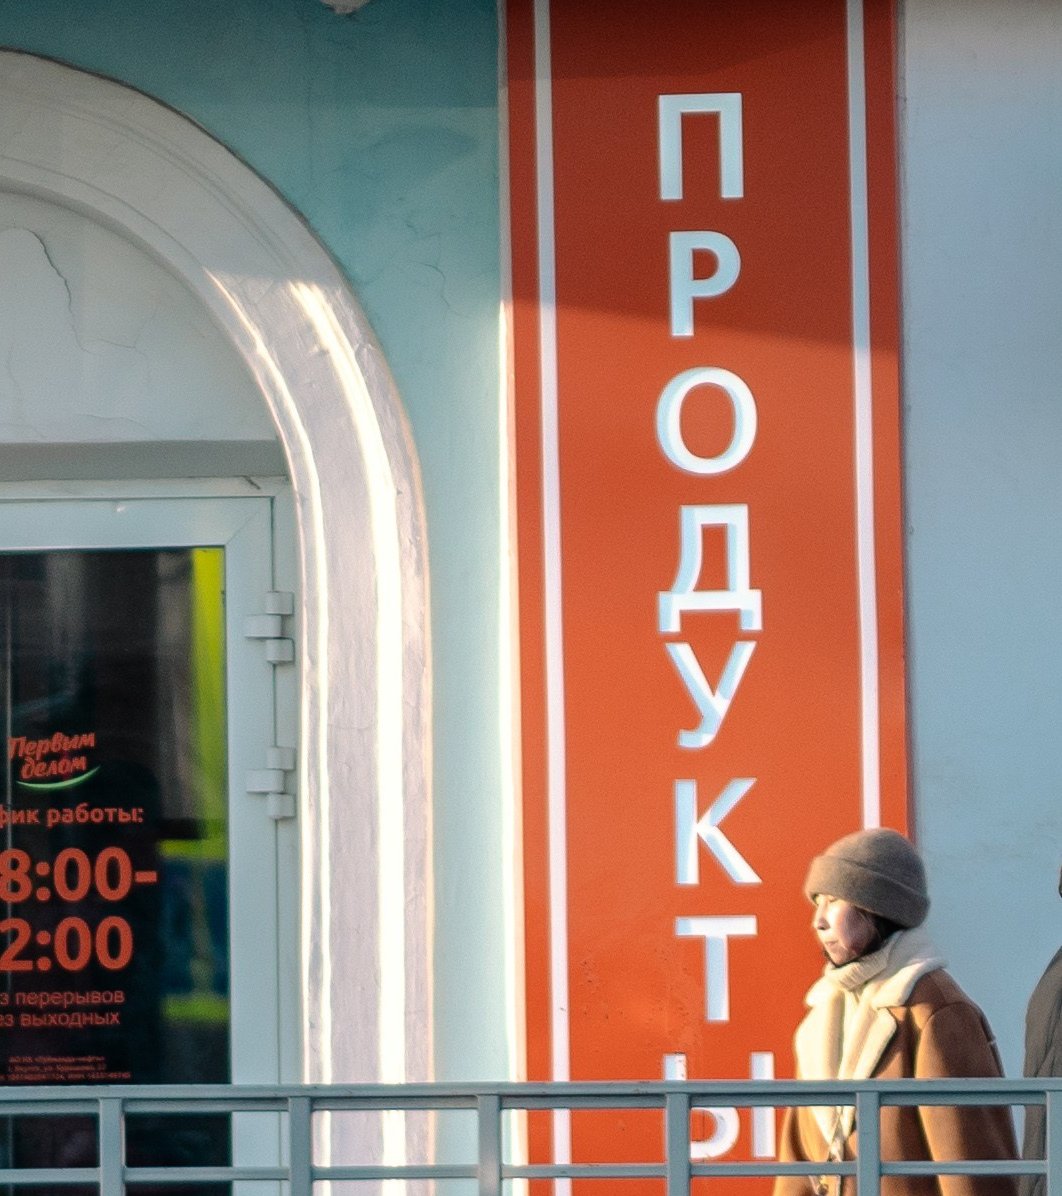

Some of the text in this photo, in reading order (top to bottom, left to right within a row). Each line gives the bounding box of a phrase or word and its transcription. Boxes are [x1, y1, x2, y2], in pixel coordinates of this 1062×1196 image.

[7, 731, 96, 760] Первым
[20, 756, 88, 779] делом
[46, 802, 144, 828] работы:
[15, 990, 125, 1008] перерывов
[20, 1011, 121, 1028] выходных
